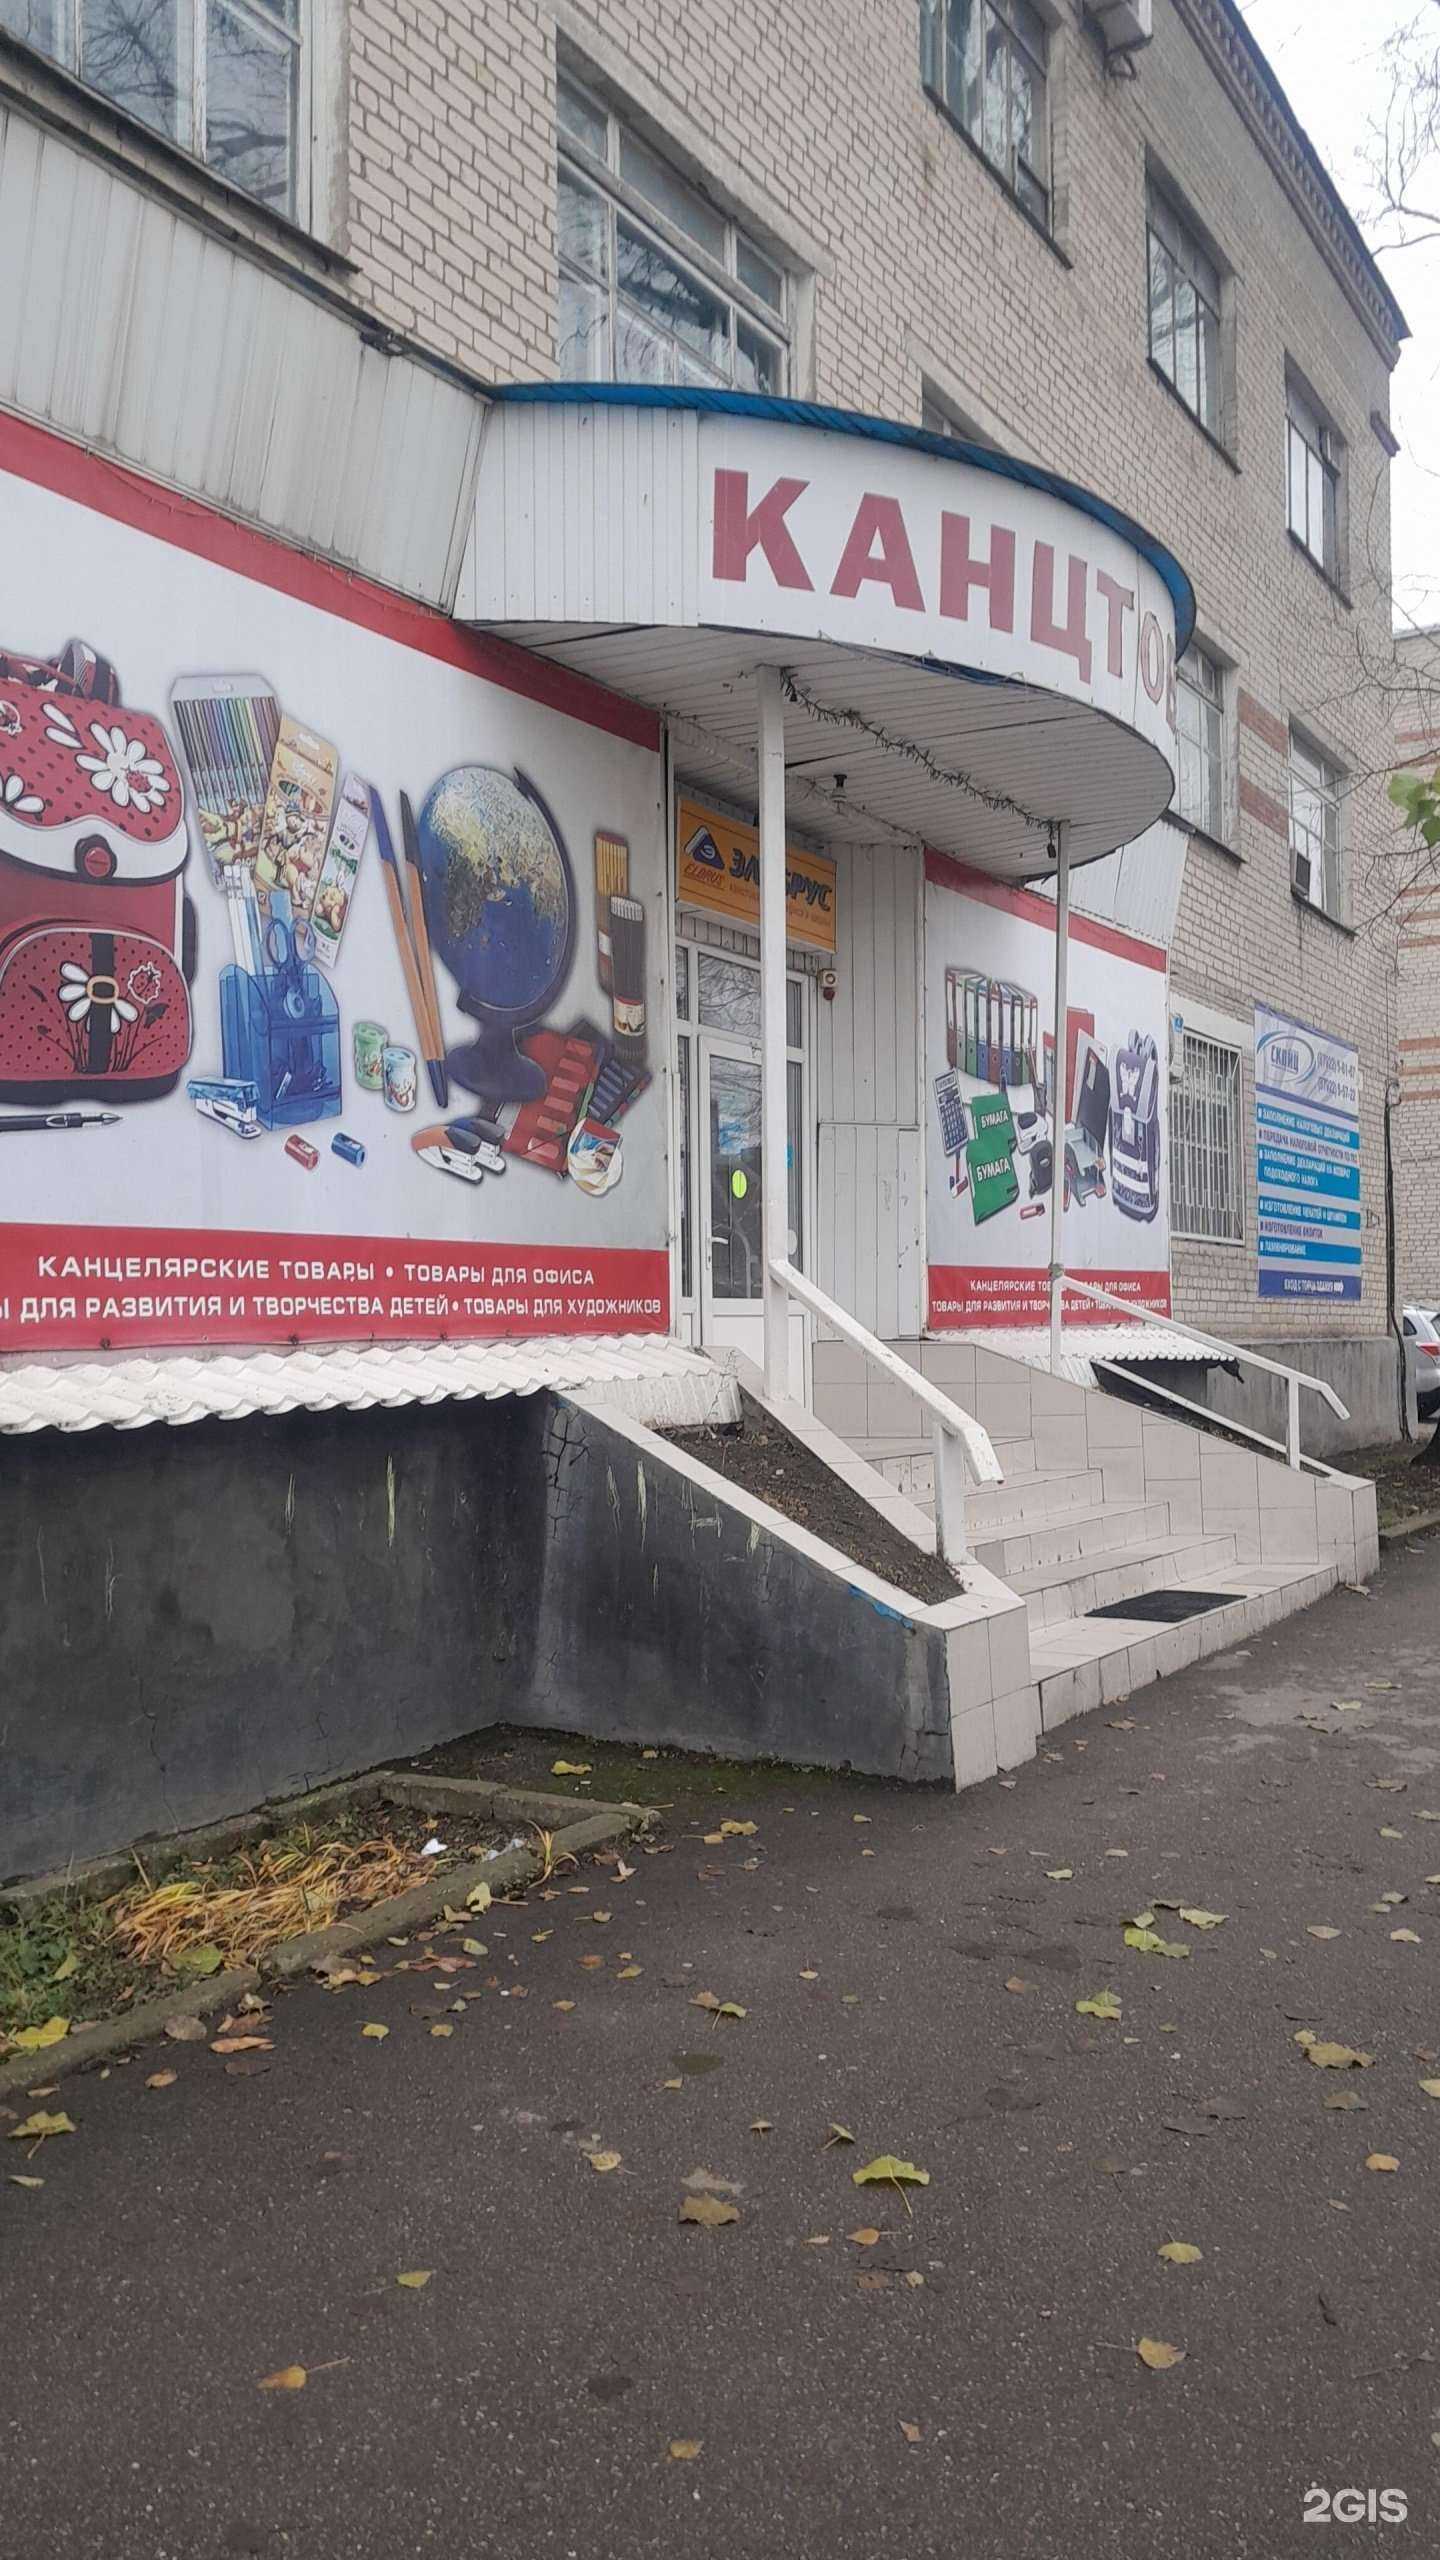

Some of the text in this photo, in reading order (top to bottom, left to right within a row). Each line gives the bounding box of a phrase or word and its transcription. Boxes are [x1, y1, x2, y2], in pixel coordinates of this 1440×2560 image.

[981, 1109, 1009, 1128] БУМАГА
[976, 1157, 1011, 1181] БУМАГА
[38, 1256, 594, 1286] КАНЦЕЛЯРСКИЕ ТОВАРЫ ТОВАРЫ ДЛЯ ОФИСА
[970, 1280, 1036, 1292] КАНЦЕЛЯРСКИЕ
[1119, 1282, 1142, 1292] ОФИСА
[20, 1297, 76, 1323] ДЛЯ
[85, 1296, 221, 1318] РАЗВИТИЯ
[229, 1296, 244, 1316] И
[252, 1296, 384, 1316] ТВОРЧЕСТВА
[390, 1294, 448, 1318] ДЕТЕЙ
[463, 1298, 528, 1315] ТОВАРЫ
[533, 1298, 562, 1317] ДЛЯ
[567, 1298, 661, 1316] ХУДОЖНИКОВ
[932, 1300, 963, 1312] ТОВАРЫ
[965, 1301, 981, 1313] ДЛЯ
[982, 1300, 1020, 1312] РАЗВИТИЯ
